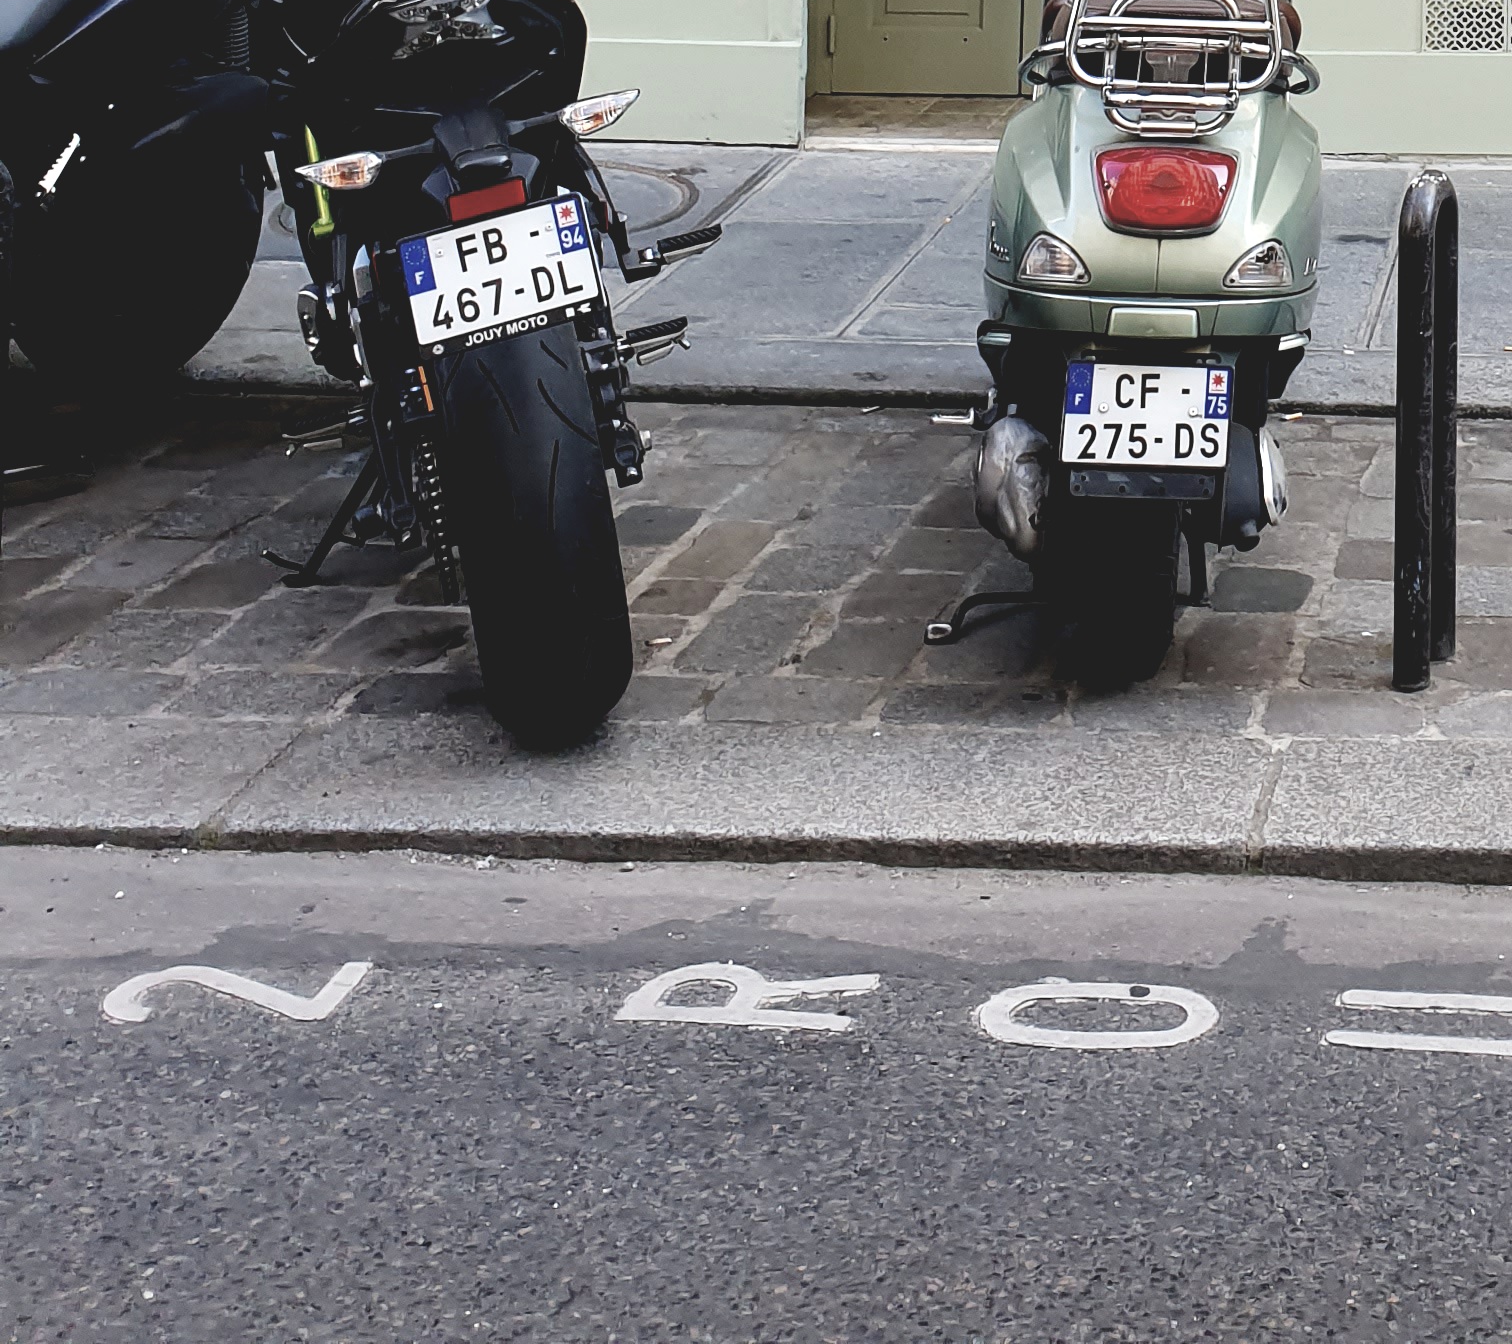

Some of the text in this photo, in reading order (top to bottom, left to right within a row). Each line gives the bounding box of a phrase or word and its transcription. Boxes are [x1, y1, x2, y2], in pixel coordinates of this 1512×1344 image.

[455, 227, 508, 273] FB
[560, 227, 584, 249] 94
[414, 270, 425, 286] F
[464, 314, 549, 348] JOUY MOTO
[1074, 393, 1084, 406] F
[1115, 373, 1161, 409] CF
[1207, 395, 1227, 415] 75
[98, 960, 374, 1024] 2
